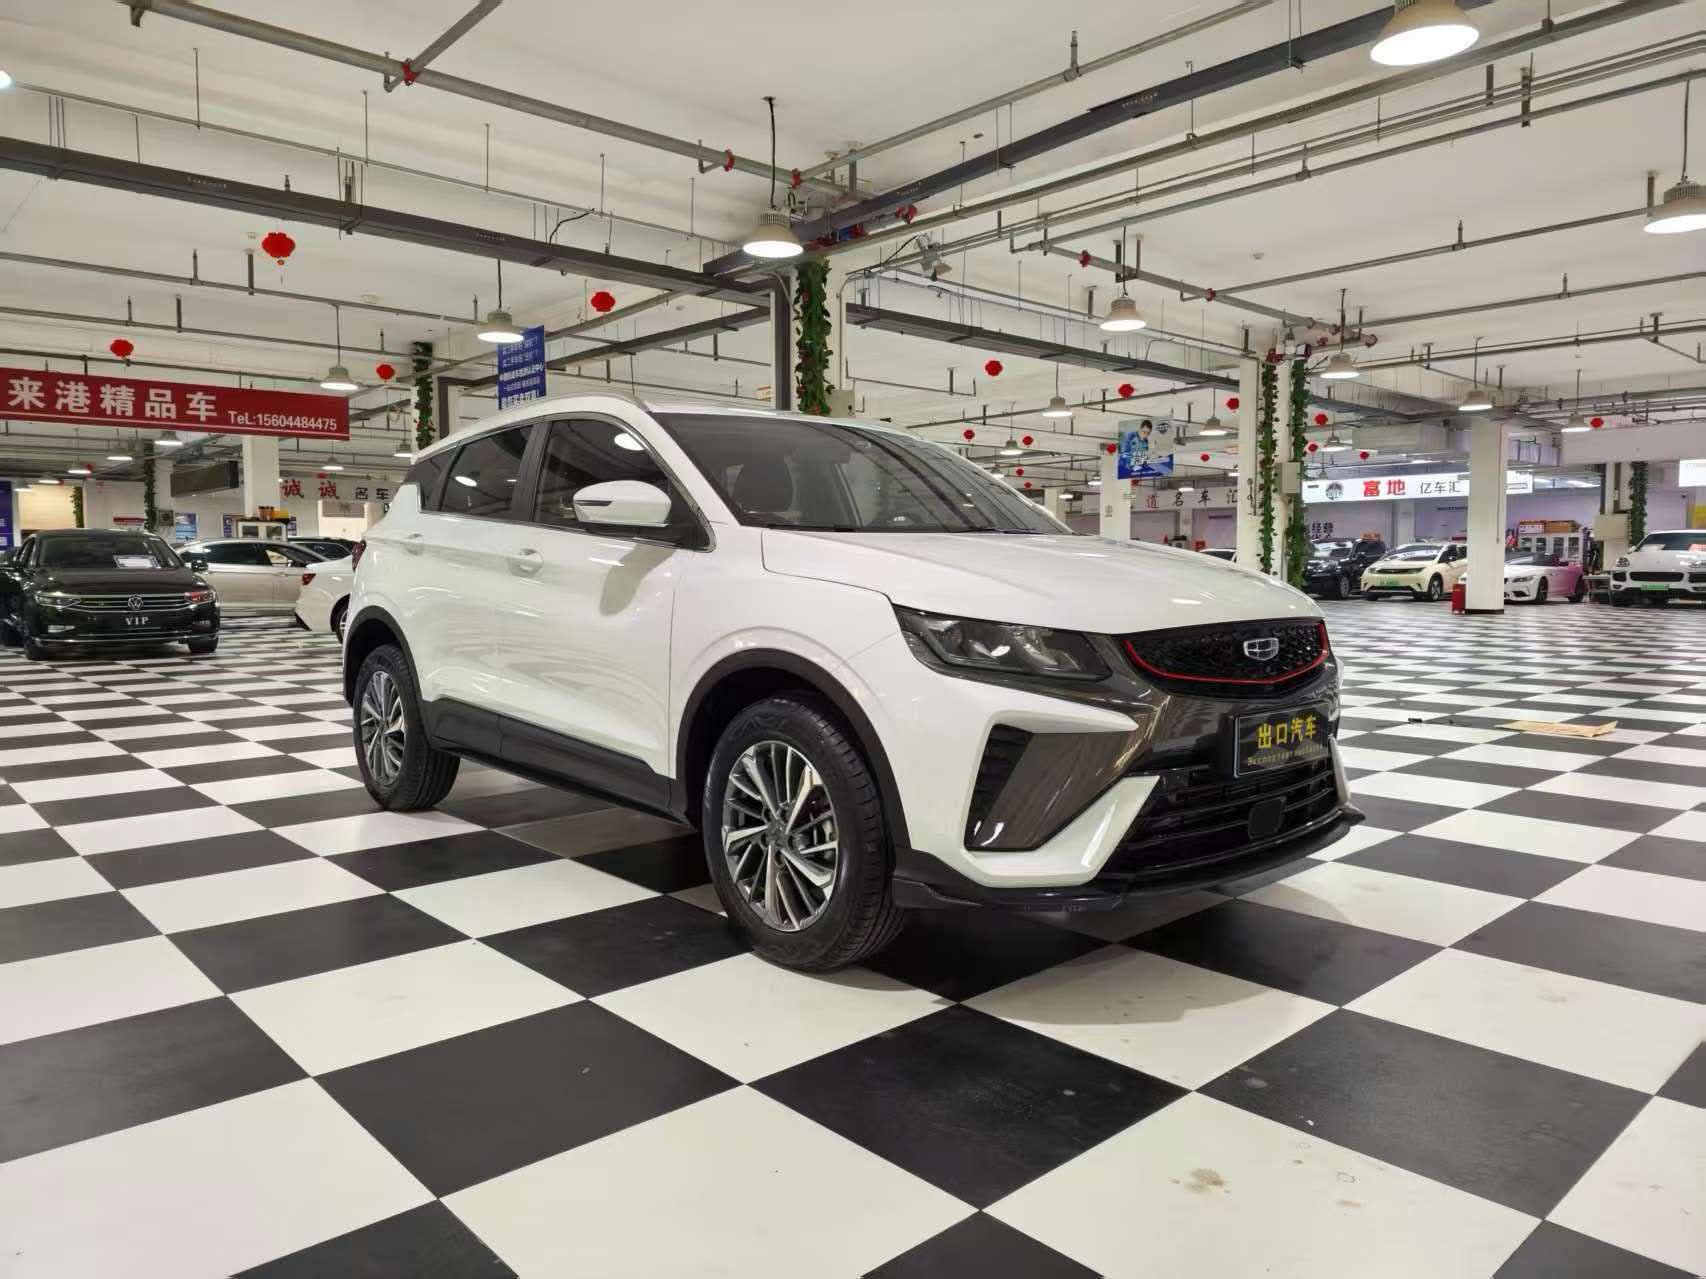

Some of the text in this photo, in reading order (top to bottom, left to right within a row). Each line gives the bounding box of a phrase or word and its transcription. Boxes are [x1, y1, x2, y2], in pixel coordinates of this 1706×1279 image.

[8, 376, 218, 422] 来港精品车
[1363, 479, 1406, 497] 富地
[126, 616, 149, 625] VIP
[1257, 715, 1317, 749] 出口汽车
